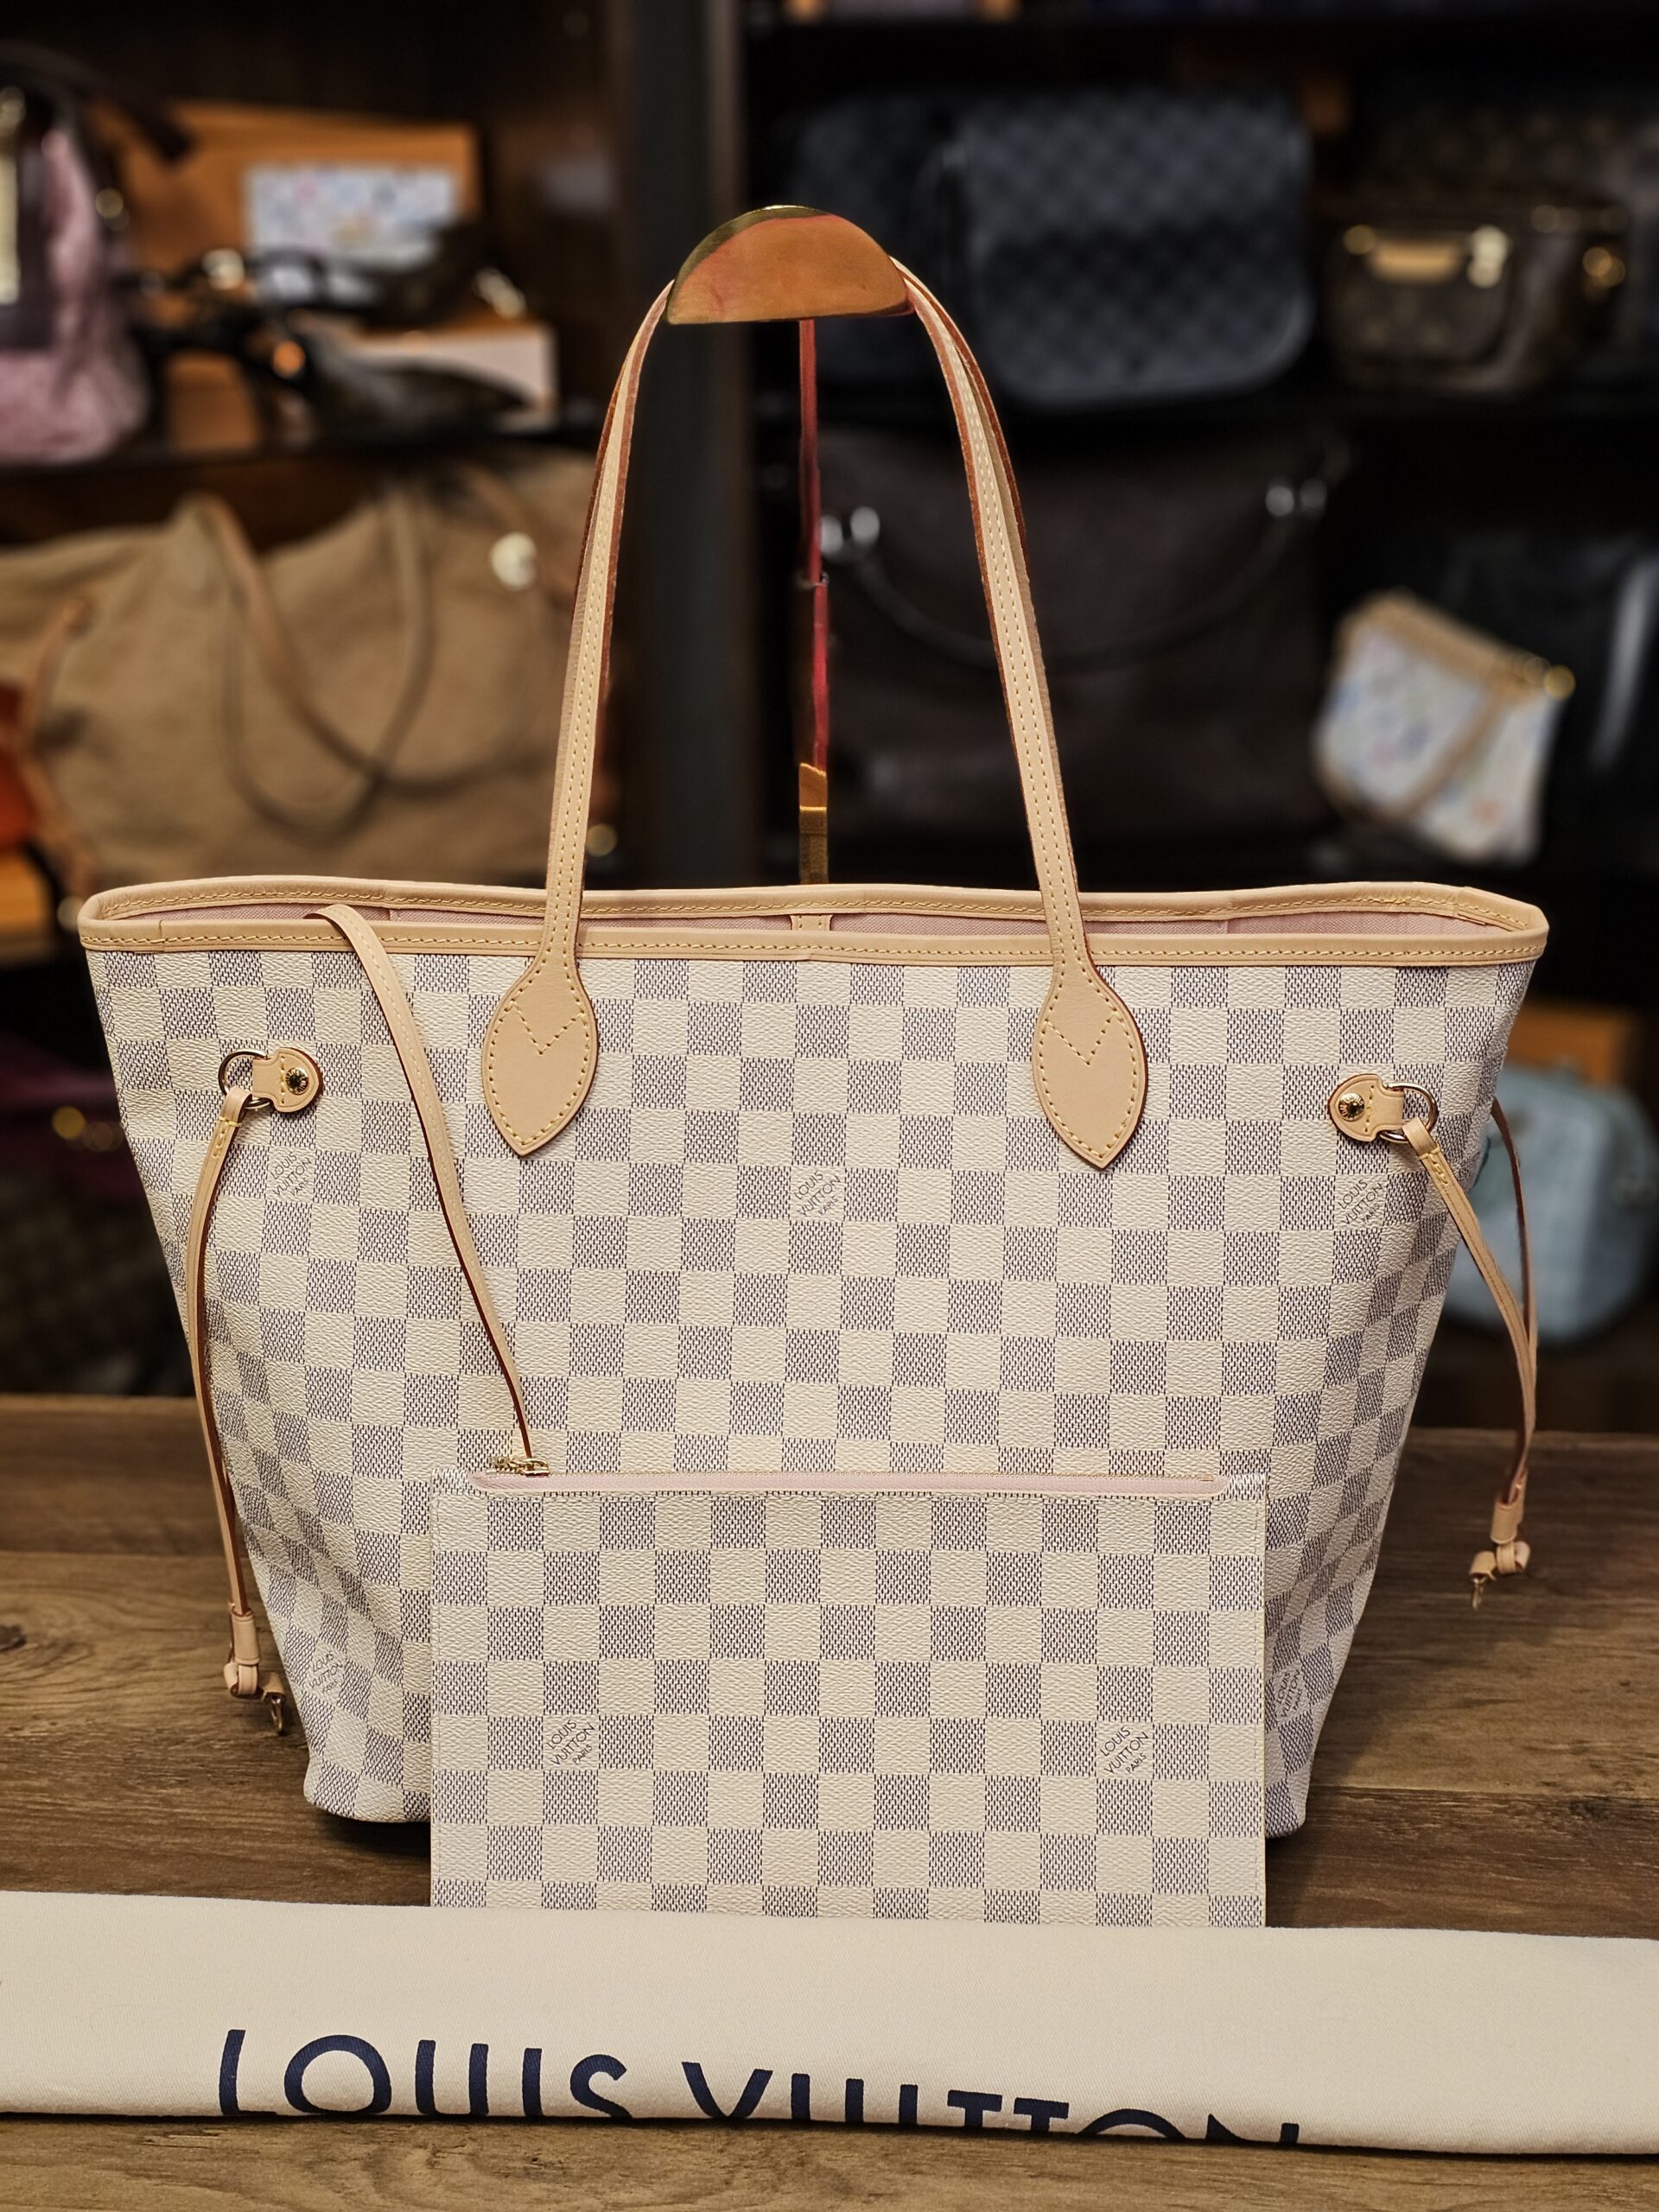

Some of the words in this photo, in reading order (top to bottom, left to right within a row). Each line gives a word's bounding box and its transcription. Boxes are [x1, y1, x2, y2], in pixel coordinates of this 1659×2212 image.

[270, 1152, 296, 1179] LOUIS
[273, 1157, 311, 1196] VUITTON
[794, 1170, 823, 1199] LOUIS
[796, 1175, 841, 1216] VUITTON
[1338, 1179, 1368, 1210] LOUIS
[1341, 1183, 1383, 1224] VUITTON
[546, 1719, 576, 1749] LOUIS
[550, 1722, 595, 1765] VUITTON
[1100, 1727, 1130, 1757] LOUIS
[573, 1744, 593, 1764] PARIS
[1103, 1731, 1149, 1774] VUITTON
[1126, 1752, 1147, 1773] PARIS
[219, 2030, 632, 2120] LOUIS
